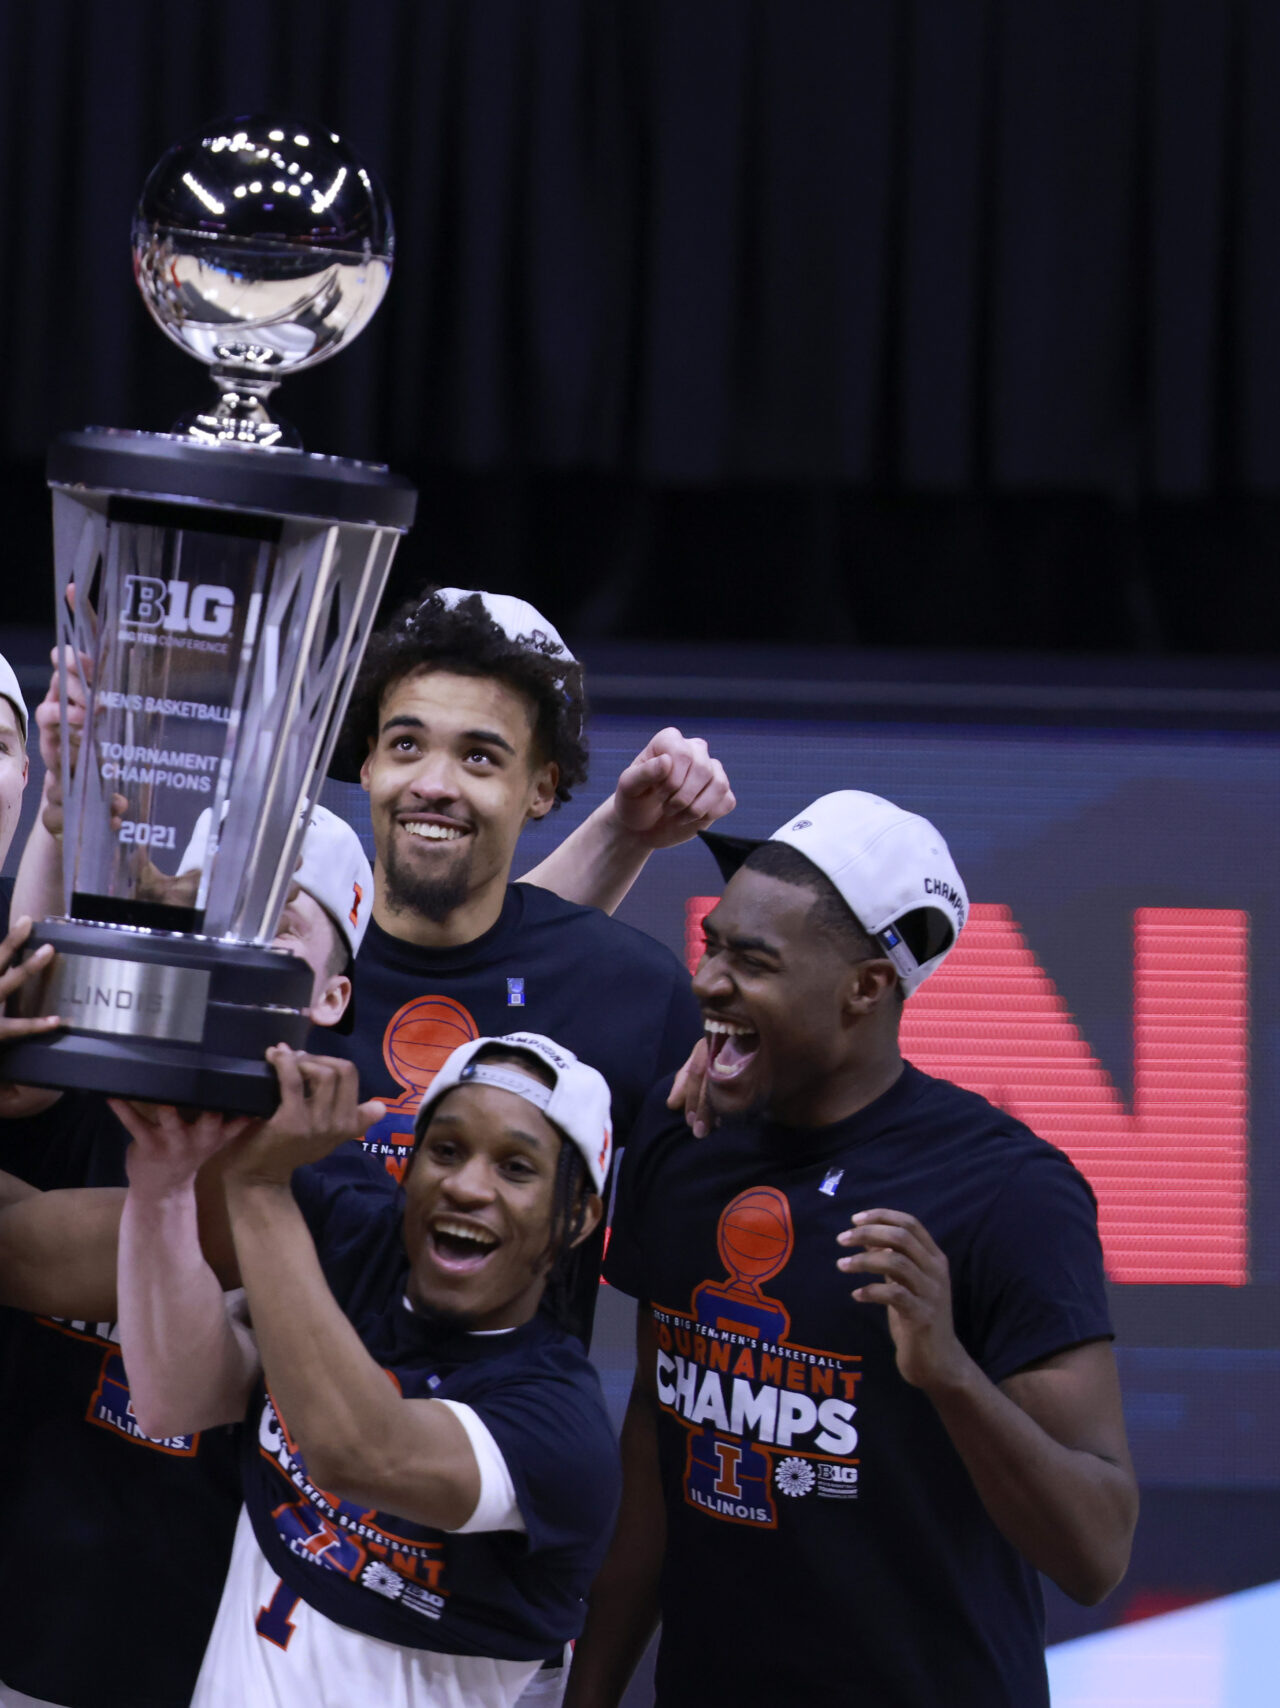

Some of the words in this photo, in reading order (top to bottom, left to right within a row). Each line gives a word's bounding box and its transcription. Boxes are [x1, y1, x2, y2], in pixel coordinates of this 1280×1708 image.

[145, 697, 231, 723] BASKETBALL
[100, 742, 219, 771] TOURNAMENT
[101, 763, 212, 792] CHAMPIONS
[120, 821, 176, 849] 2021
[674, 1317, 691, 1330] BIG
[721, 1331, 757, 1349] MEN'S
[762, 1342, 843, 1370] BASKETBALL
[656, 1349, 859, 1456] CHAMPS
[99, 1404, 186, 1449] ILLINIS
[691, 1488, 769, 1522] ILLINOIS
[339, 1514, 428, 1559] BASKETBALL
